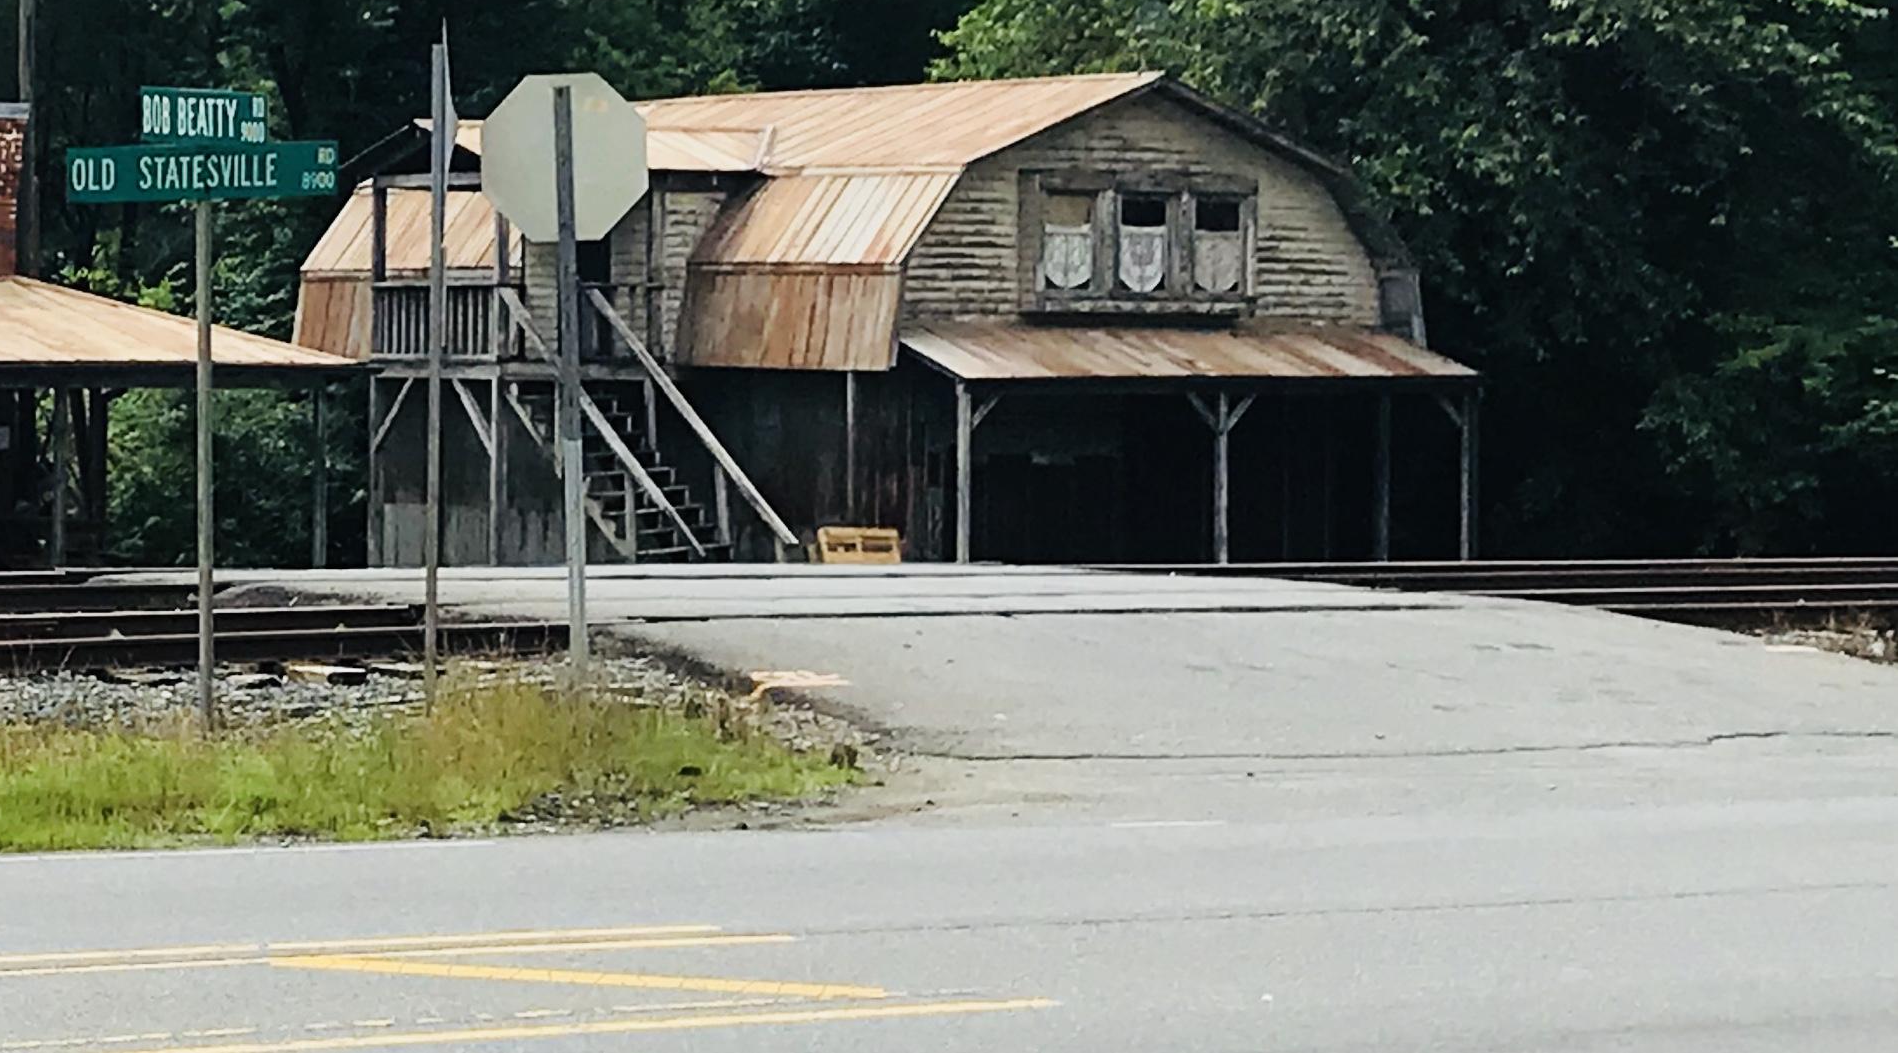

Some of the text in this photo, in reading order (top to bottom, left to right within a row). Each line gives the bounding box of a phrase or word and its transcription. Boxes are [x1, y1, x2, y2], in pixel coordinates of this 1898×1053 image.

[143, 94, 237, 138] BOB BEATTY
[317, 147, 335, 165] RD
[71, 153, 278, 192] OLD STATESVILLE
[301, 171, 335, 190] 8900
